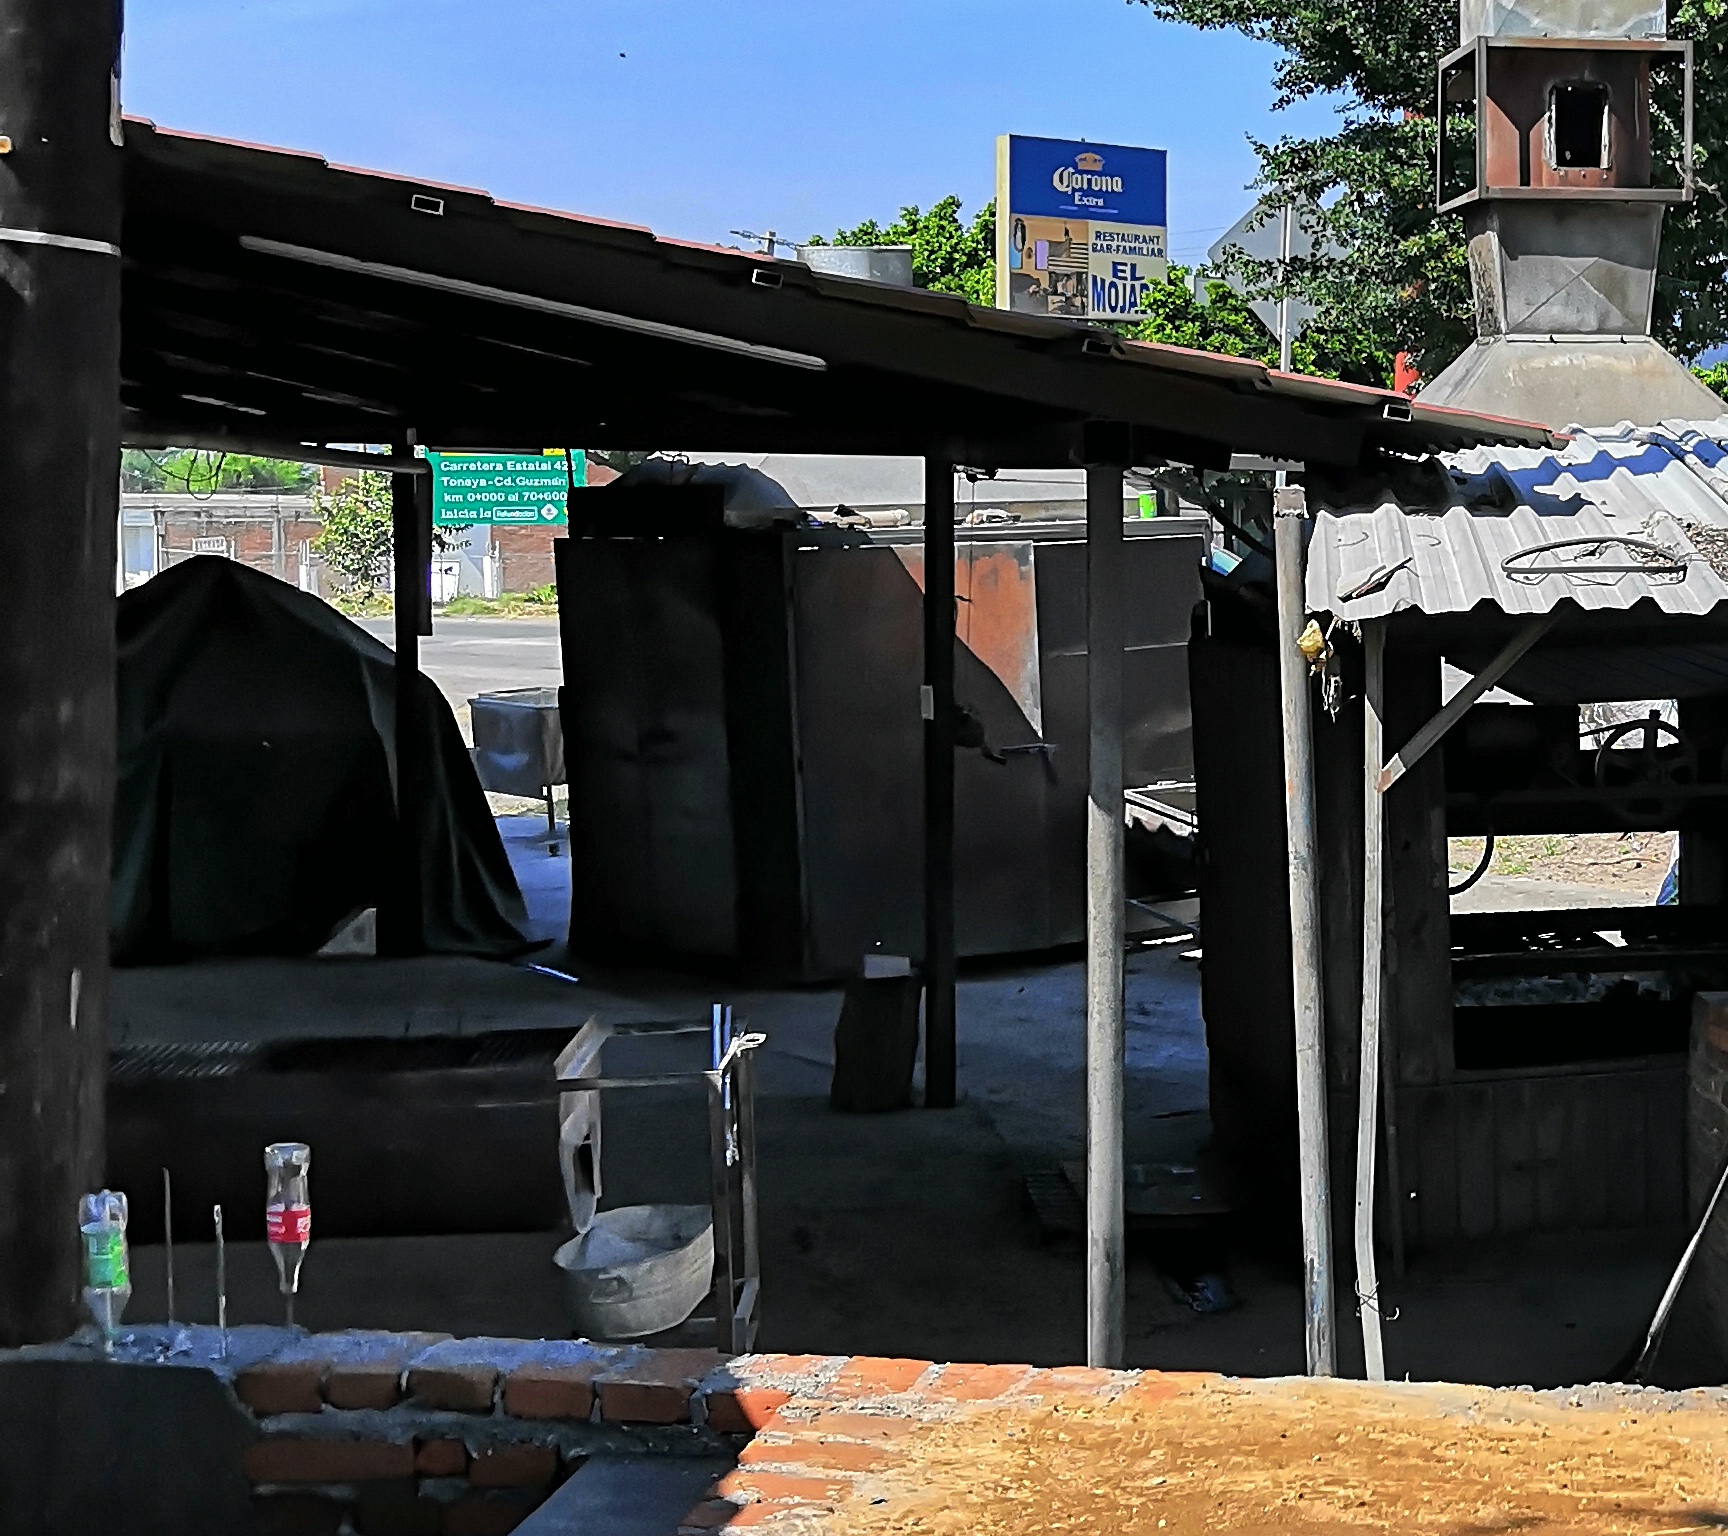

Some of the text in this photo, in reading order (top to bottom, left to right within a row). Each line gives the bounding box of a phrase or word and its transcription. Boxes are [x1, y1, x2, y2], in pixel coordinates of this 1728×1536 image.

[1053, 167, 1123, 194] Corona
[1074, 192, 1104, 206] Extra
[1095, 231, 1161, 245] RESTAURANT
[1092, 243, 1164, 258] BAR-FAMILIAR
[1112, 261, 1145, 281] EL
[440, 461, 503, 471] Carretera
[506, 460, 552, 471] Estatal
[443, 493, 463, 502] km
[440, 508, 477, 519] Inicia
[479, 507, 492, 519] la
